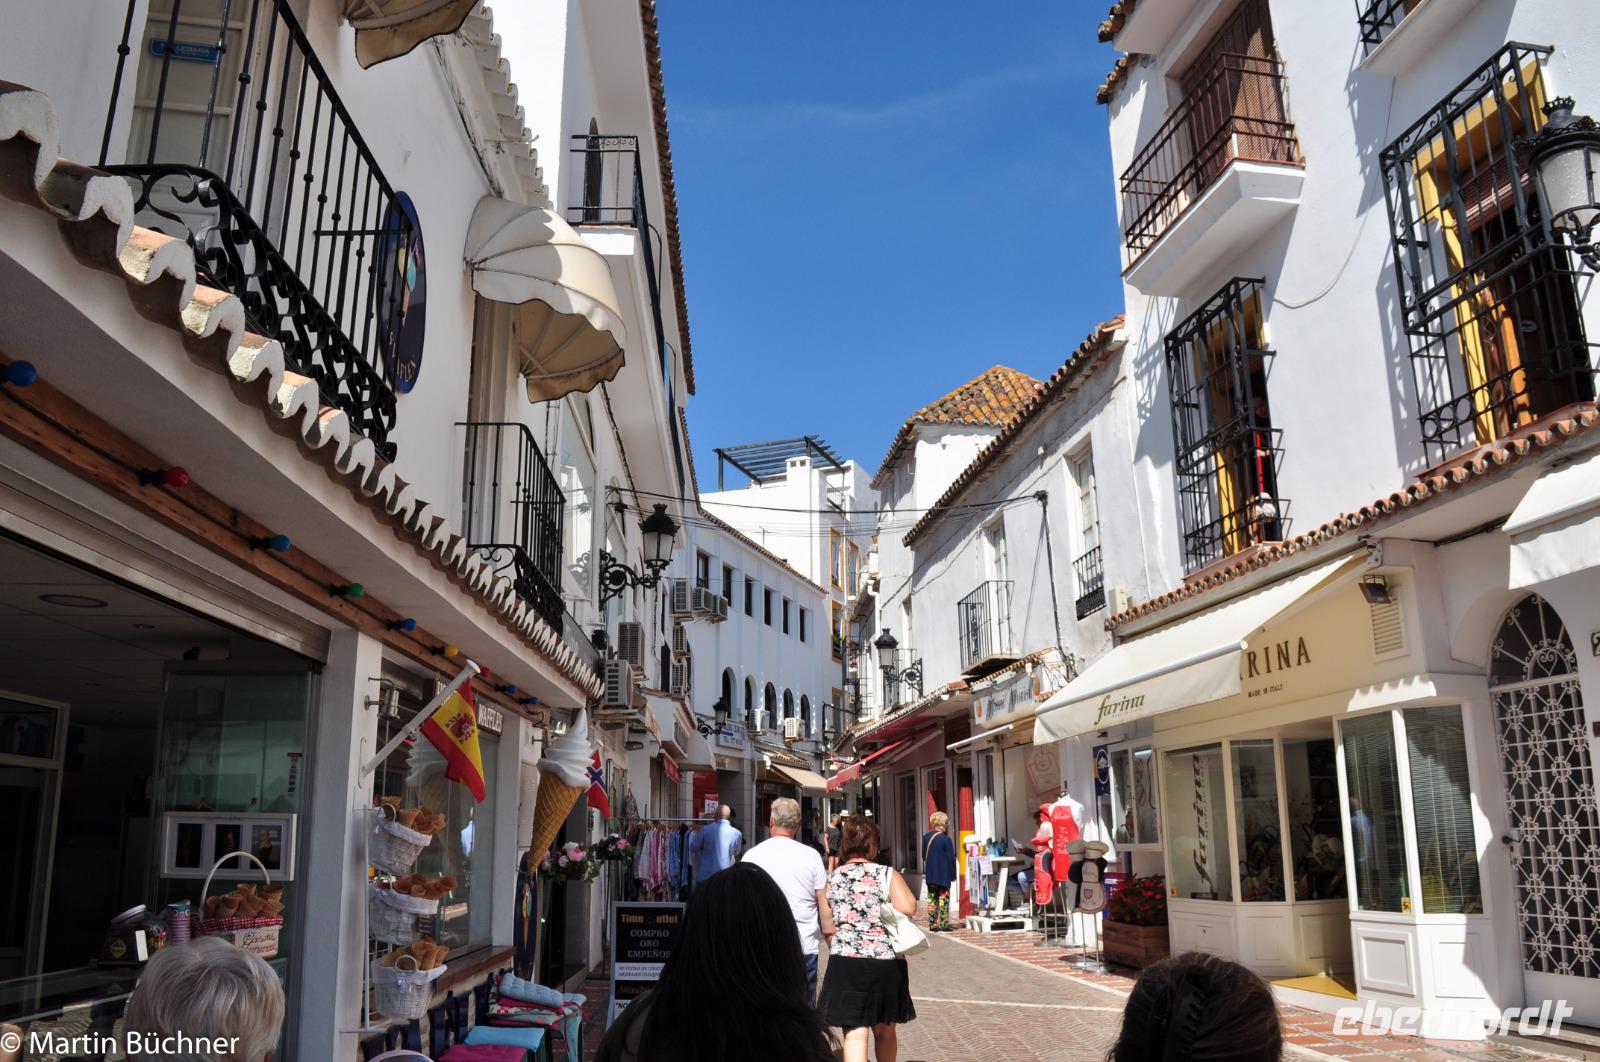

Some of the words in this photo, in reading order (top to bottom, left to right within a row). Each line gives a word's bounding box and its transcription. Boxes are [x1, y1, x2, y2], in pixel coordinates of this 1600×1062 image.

[1240, 636, 1311, 680] RINA
[1270, 683, 1283, 693] ITALY
[1094, 694, 1145, 725] farina
[478, 704, 503, 733] WAFFLES
[621, 914, 645, 923] Time
[649, 914, 679, 924] utlet
[630, 929, 670, 938] COMPRO
[639, 940, 660, 948] ORO
[627, 949, 672, 959] EMPEÑOS
